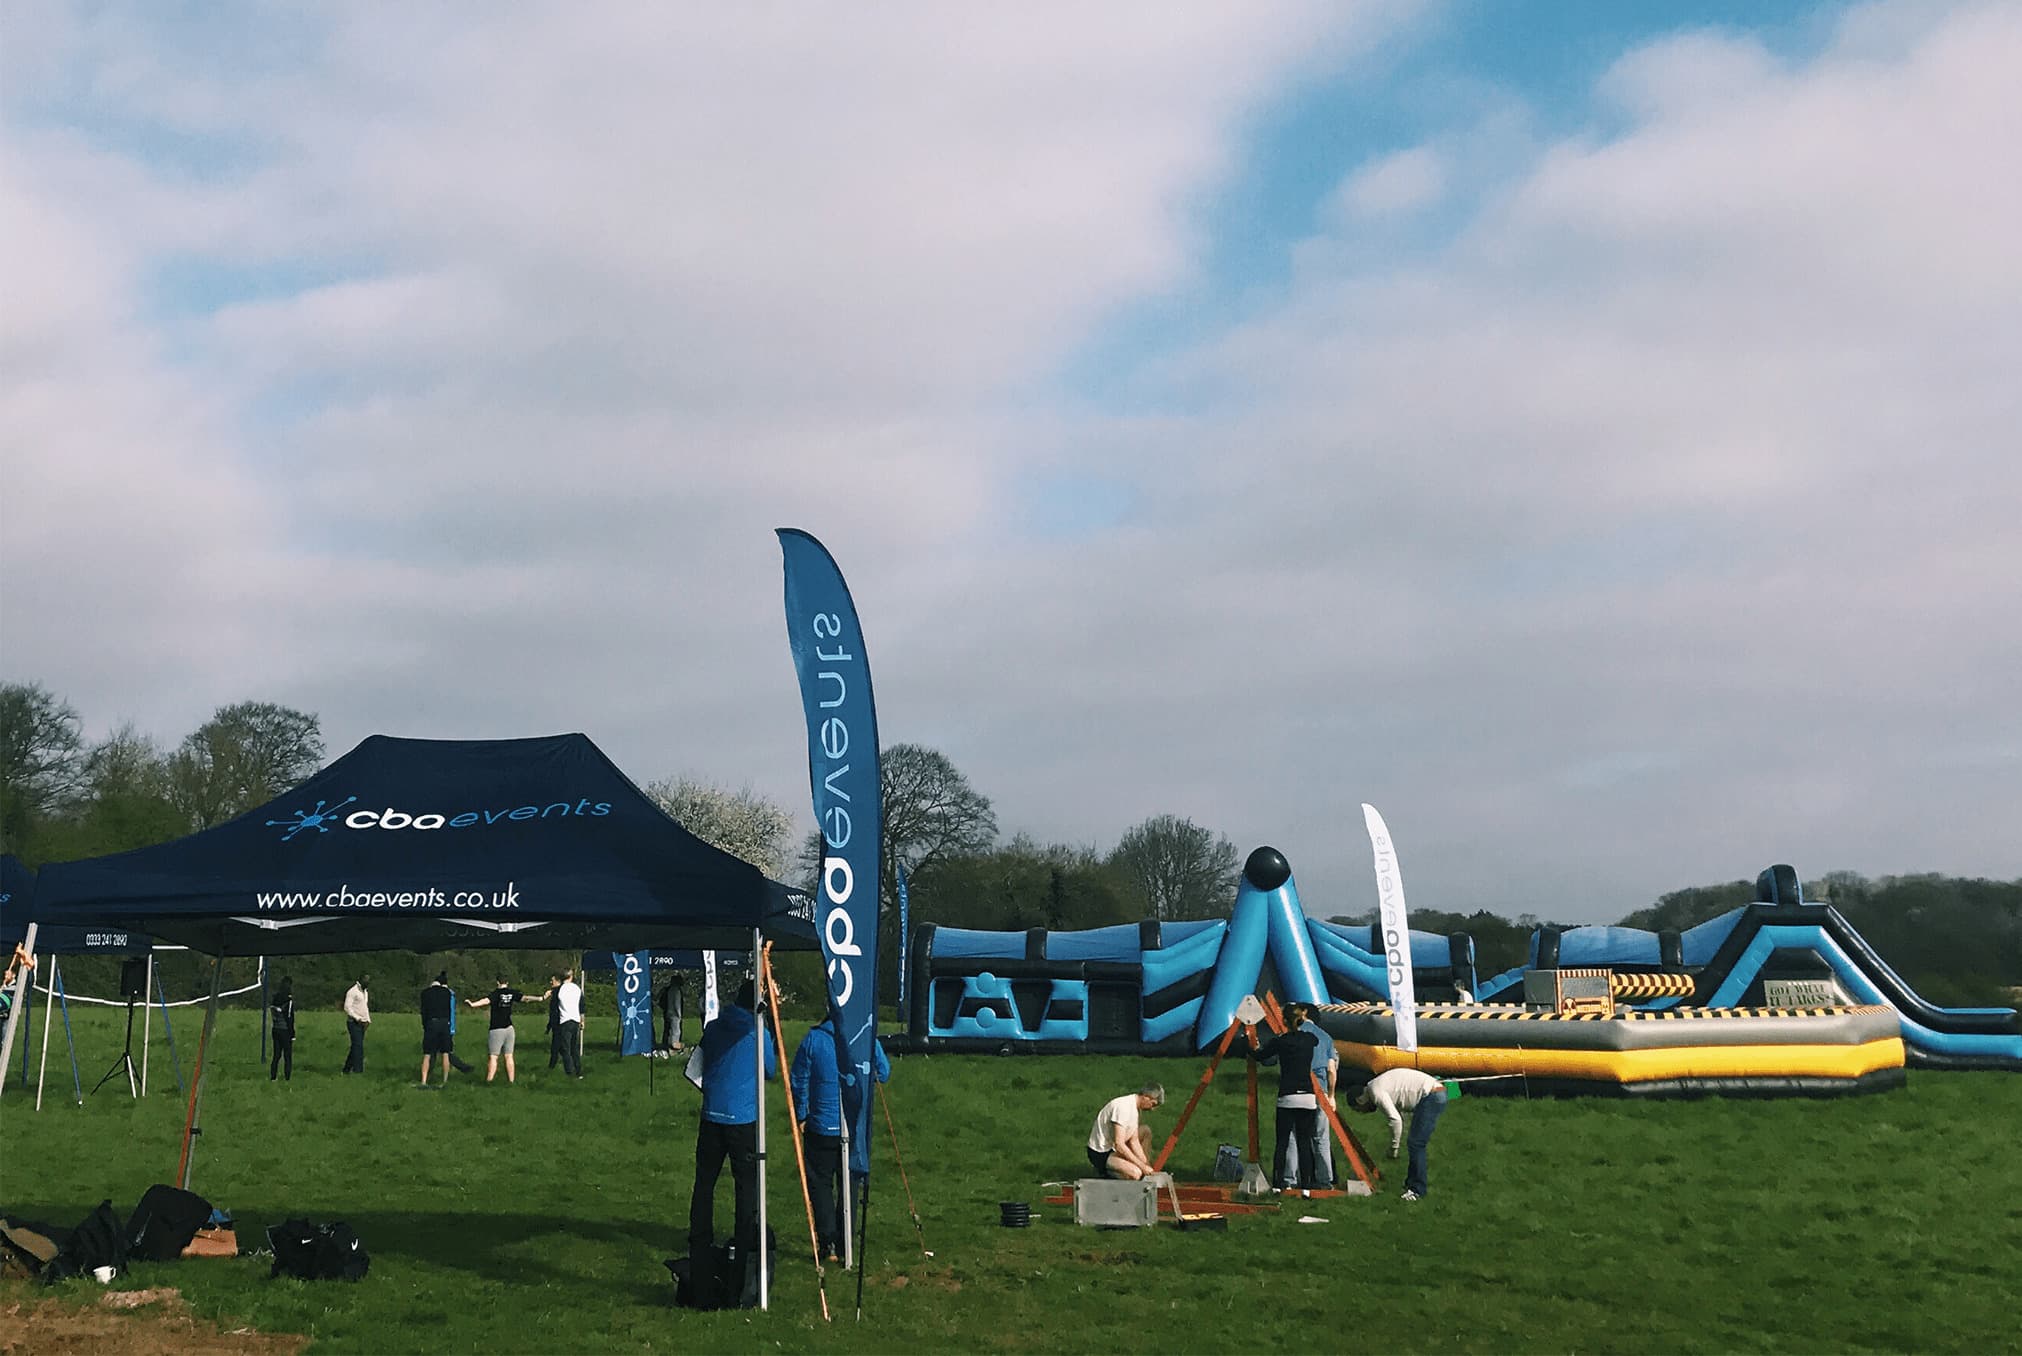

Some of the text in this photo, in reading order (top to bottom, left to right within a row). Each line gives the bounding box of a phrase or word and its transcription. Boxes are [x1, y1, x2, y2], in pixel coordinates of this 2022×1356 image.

[345, 797, 613, 831] cbaevents
[257, 882, 520, 909] www.cbaevents.co.uk
[102, 933, 112, 946] 241
